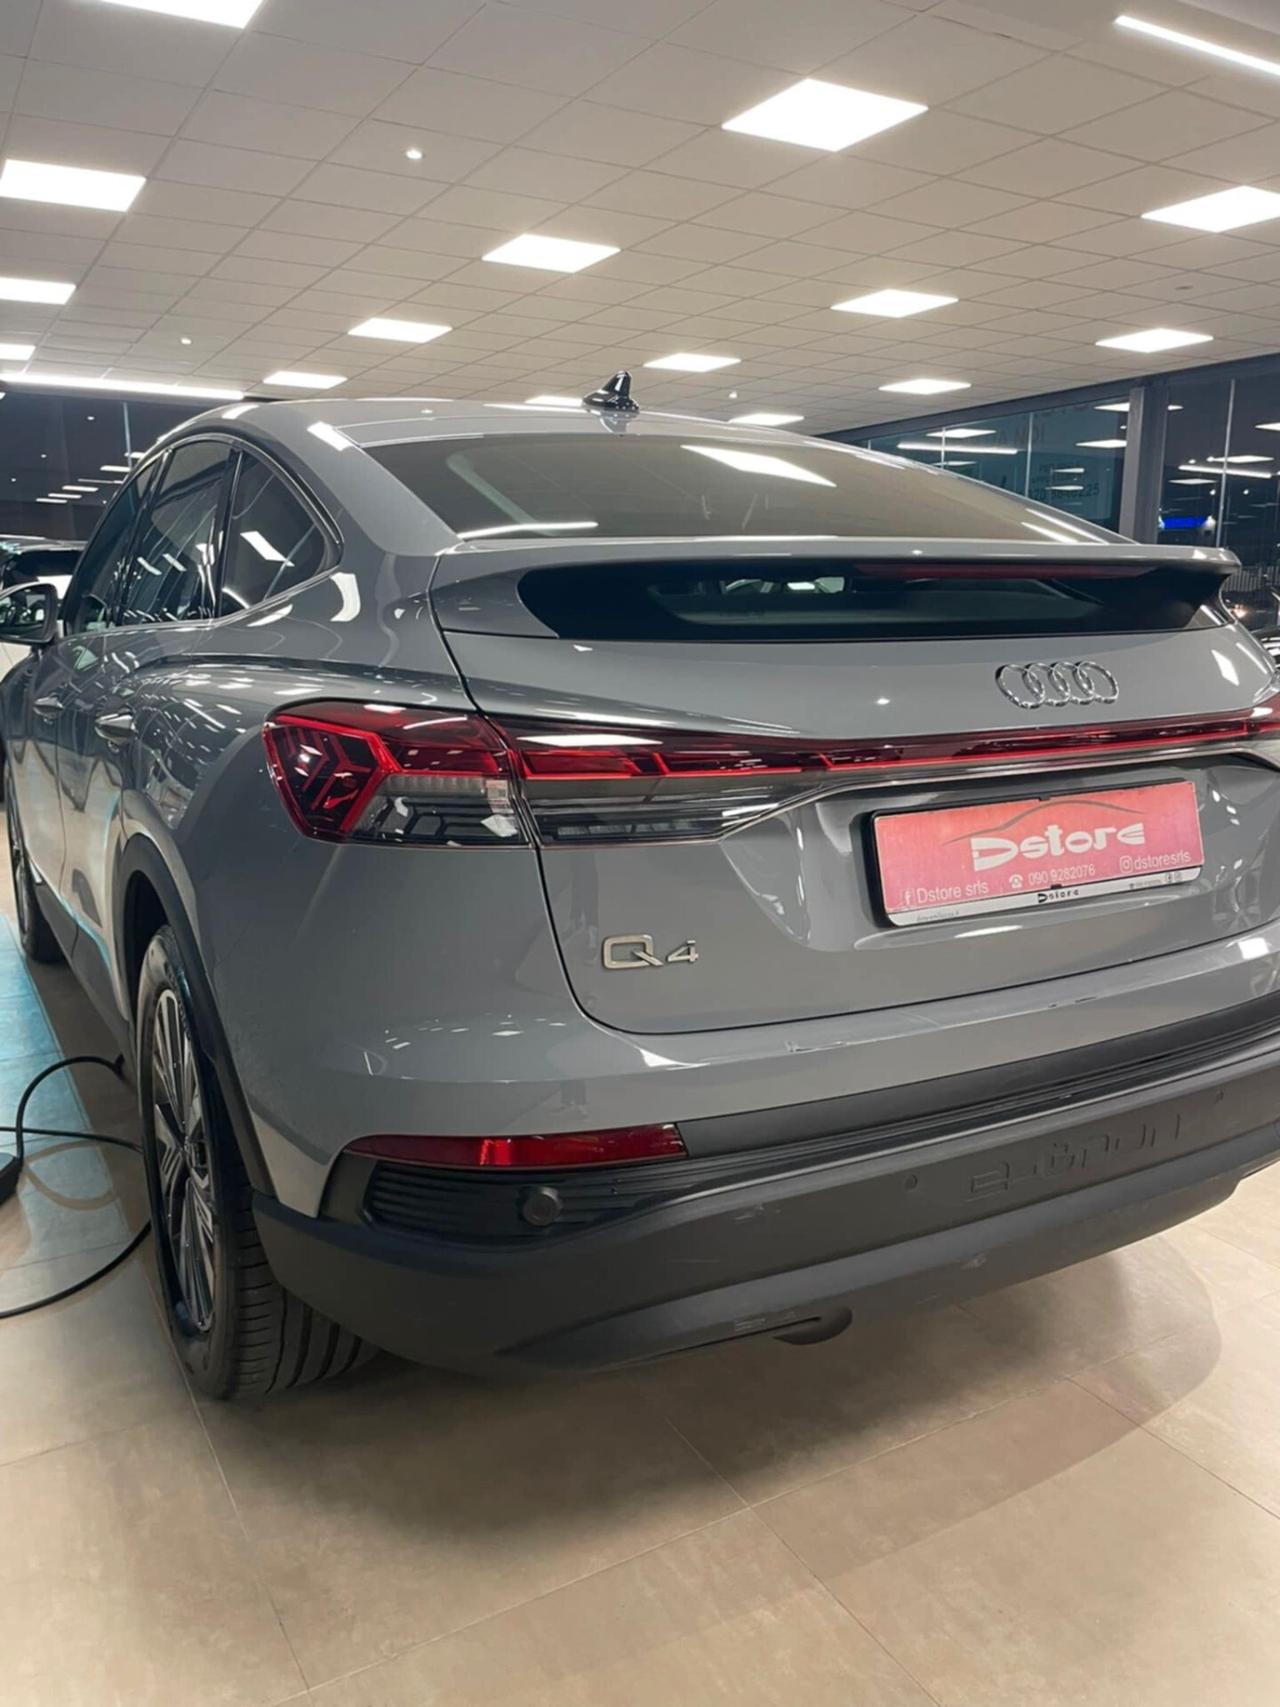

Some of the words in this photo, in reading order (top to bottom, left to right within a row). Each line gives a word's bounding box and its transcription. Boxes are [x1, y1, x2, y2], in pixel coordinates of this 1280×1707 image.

[971, 823, 1146, 872] Dstore
[1134, 850, 1191, 870] dstoresrls
[1028, 870, 1049, 886] 090
[917, 887, 961, 904] Dstore
[965, 880, 989, 897] srls
[1037, 889, 1080, 904] Dstore
[602, 934, 699, 969] Q4
